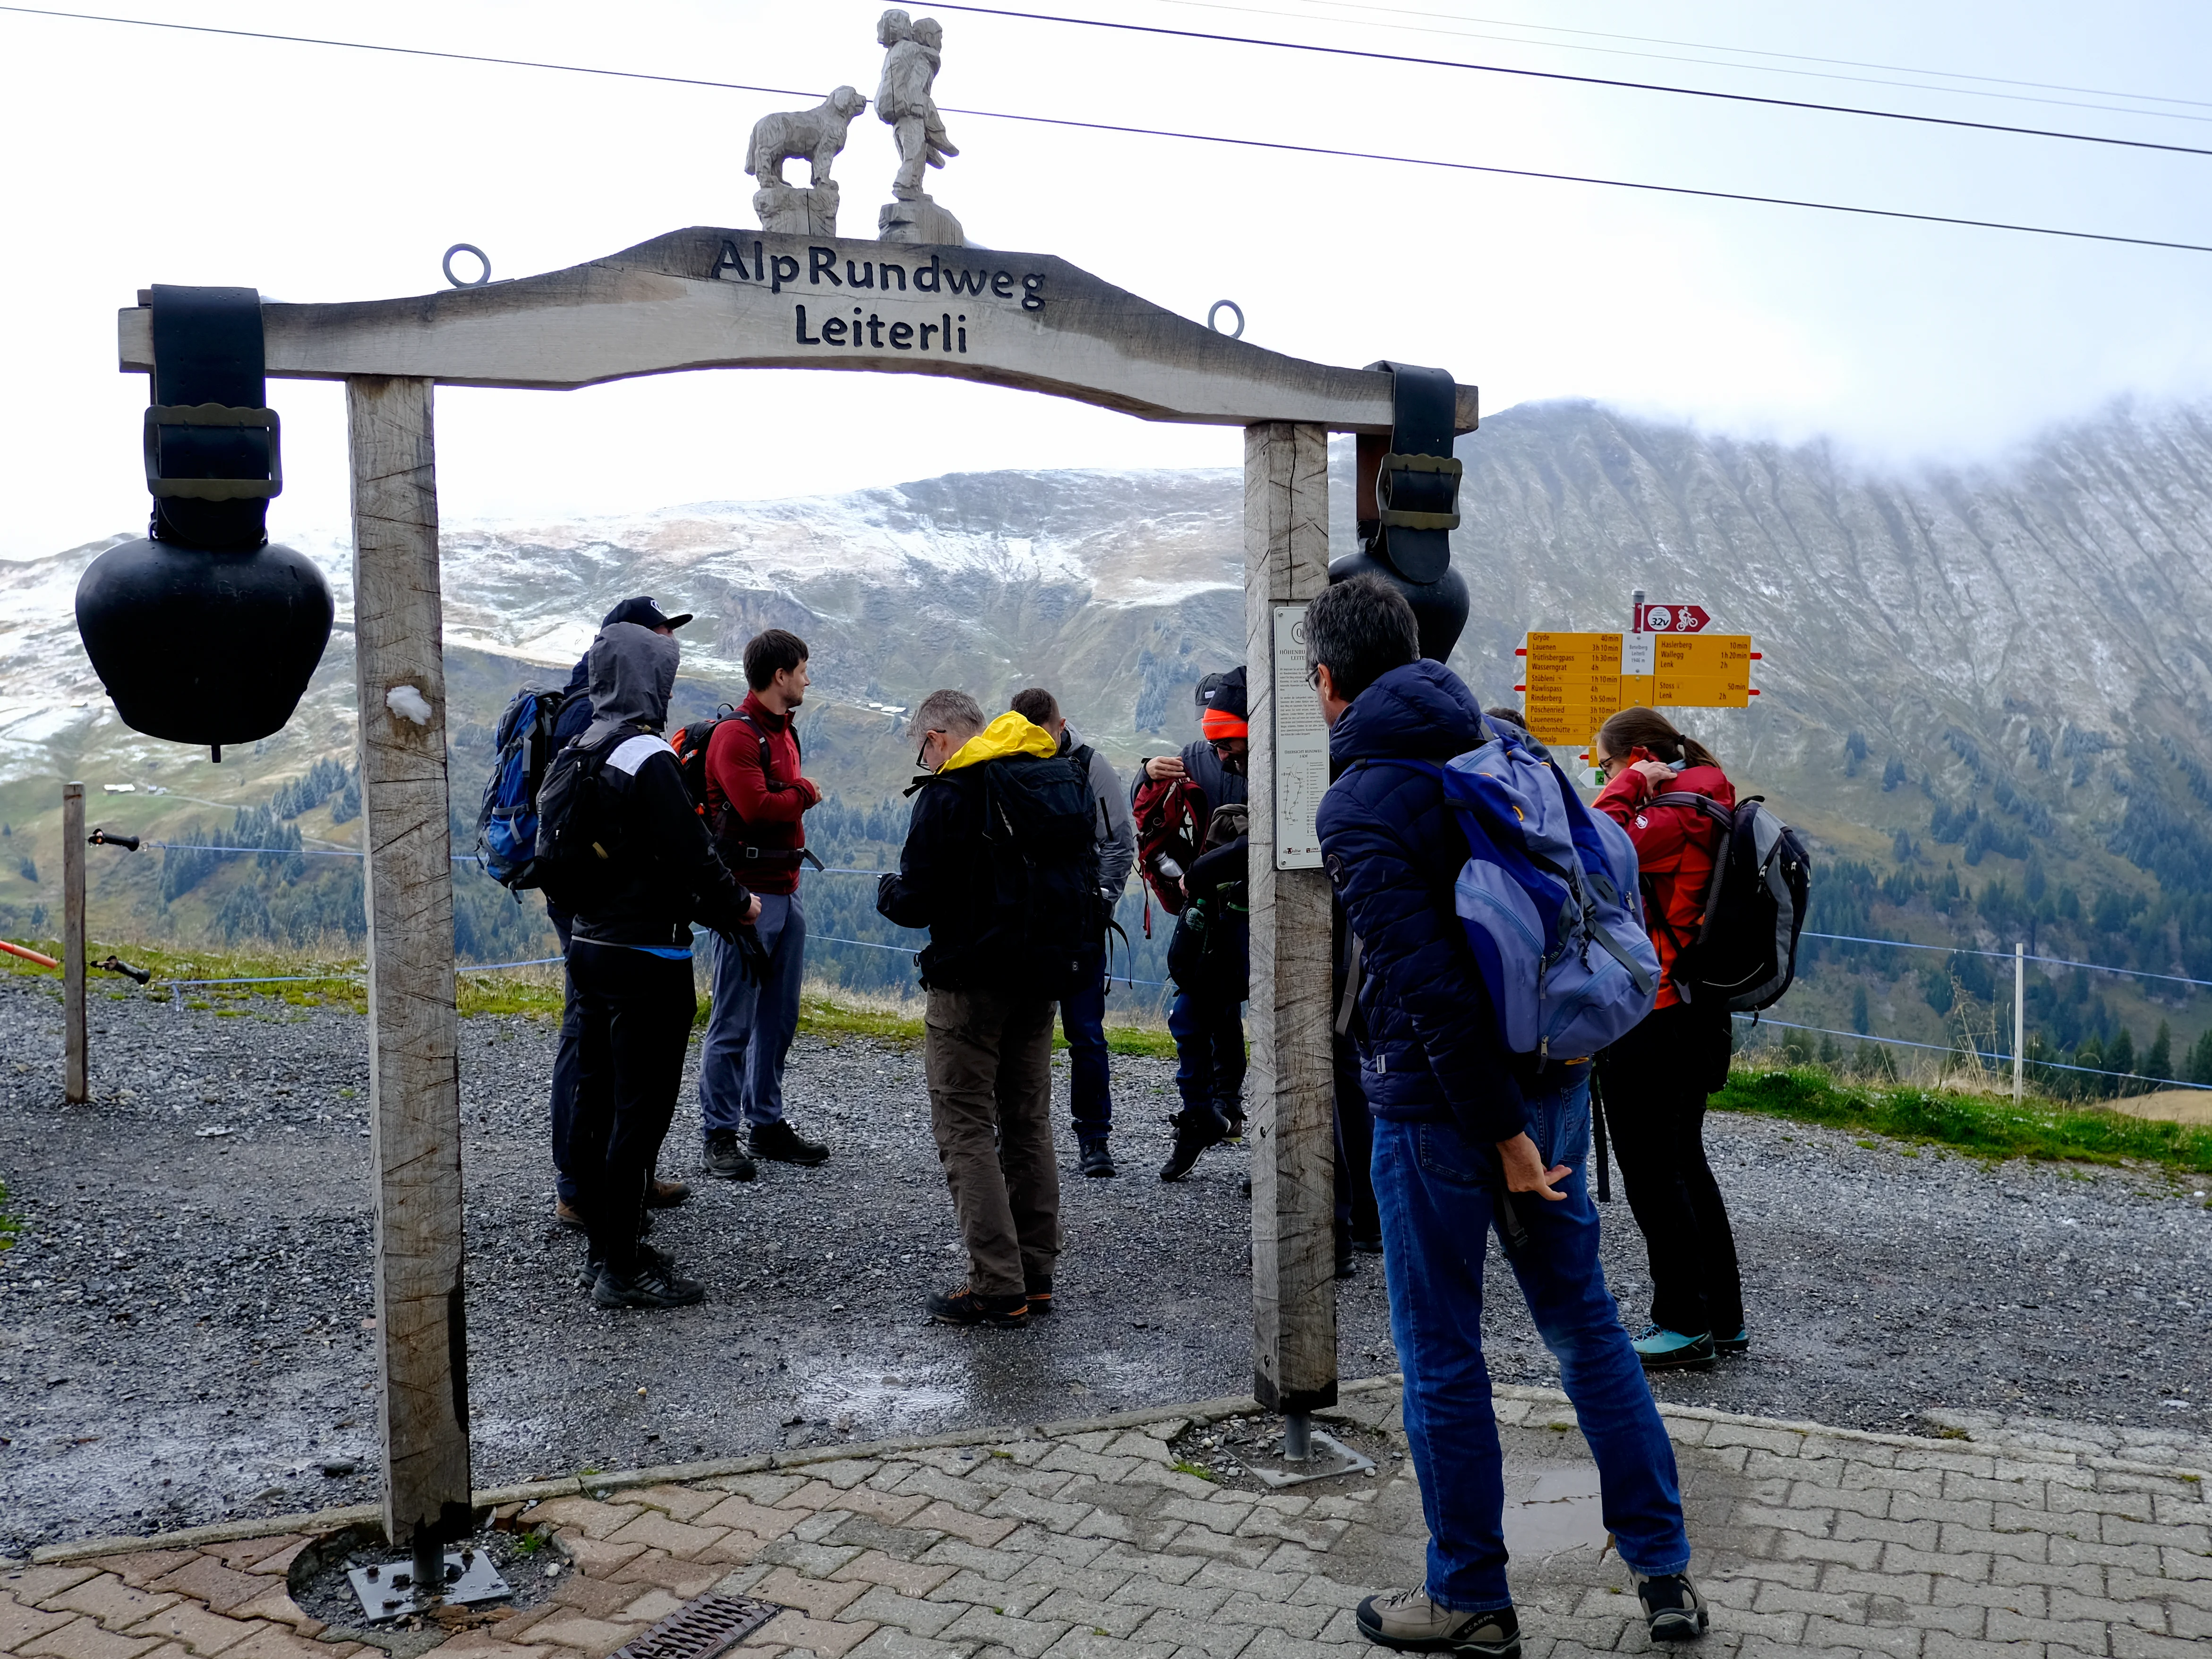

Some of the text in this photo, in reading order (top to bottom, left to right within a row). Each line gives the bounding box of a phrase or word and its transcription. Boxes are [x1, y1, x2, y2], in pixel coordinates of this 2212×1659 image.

[795, 305, 967, 353] Leiterli
[1650, 618, 1669, 626] 32v
[1533, 633, 1549, 642] Gryde
[1661, 641, 1692, 650] Haslerberg
[1661, 650, 1683, 660] Wallegg
[1532, 663, 1567, 672] Wasserngrat
[1531, 694, 1562, 704] Rinderberg
[1464, 1615, 1495, 1634] SCARPA
